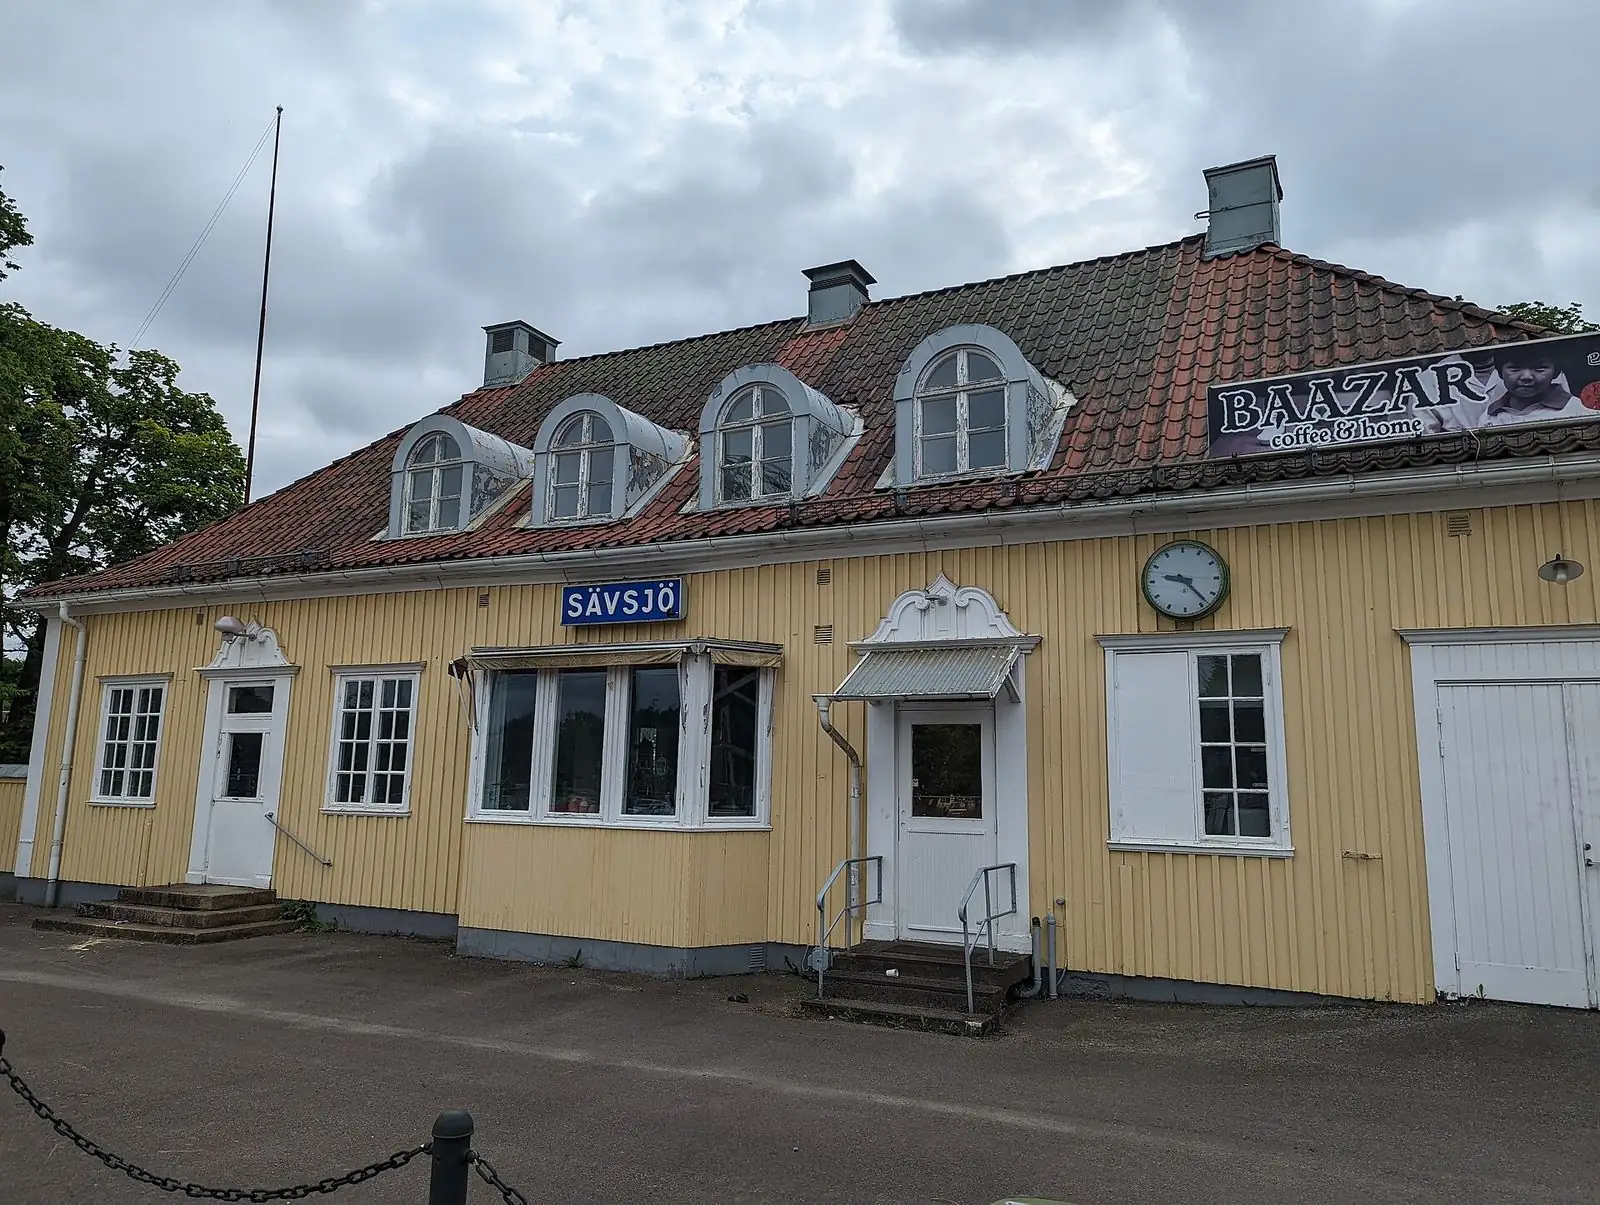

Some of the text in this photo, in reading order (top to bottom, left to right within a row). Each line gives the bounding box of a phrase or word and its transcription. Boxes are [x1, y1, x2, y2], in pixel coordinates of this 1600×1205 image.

[1219, 361, 1488, 433] BAAZAR
[1271, 417, 1422, 448] coffee & home
[567, 582, 675, 617] SÄVSJÖ
